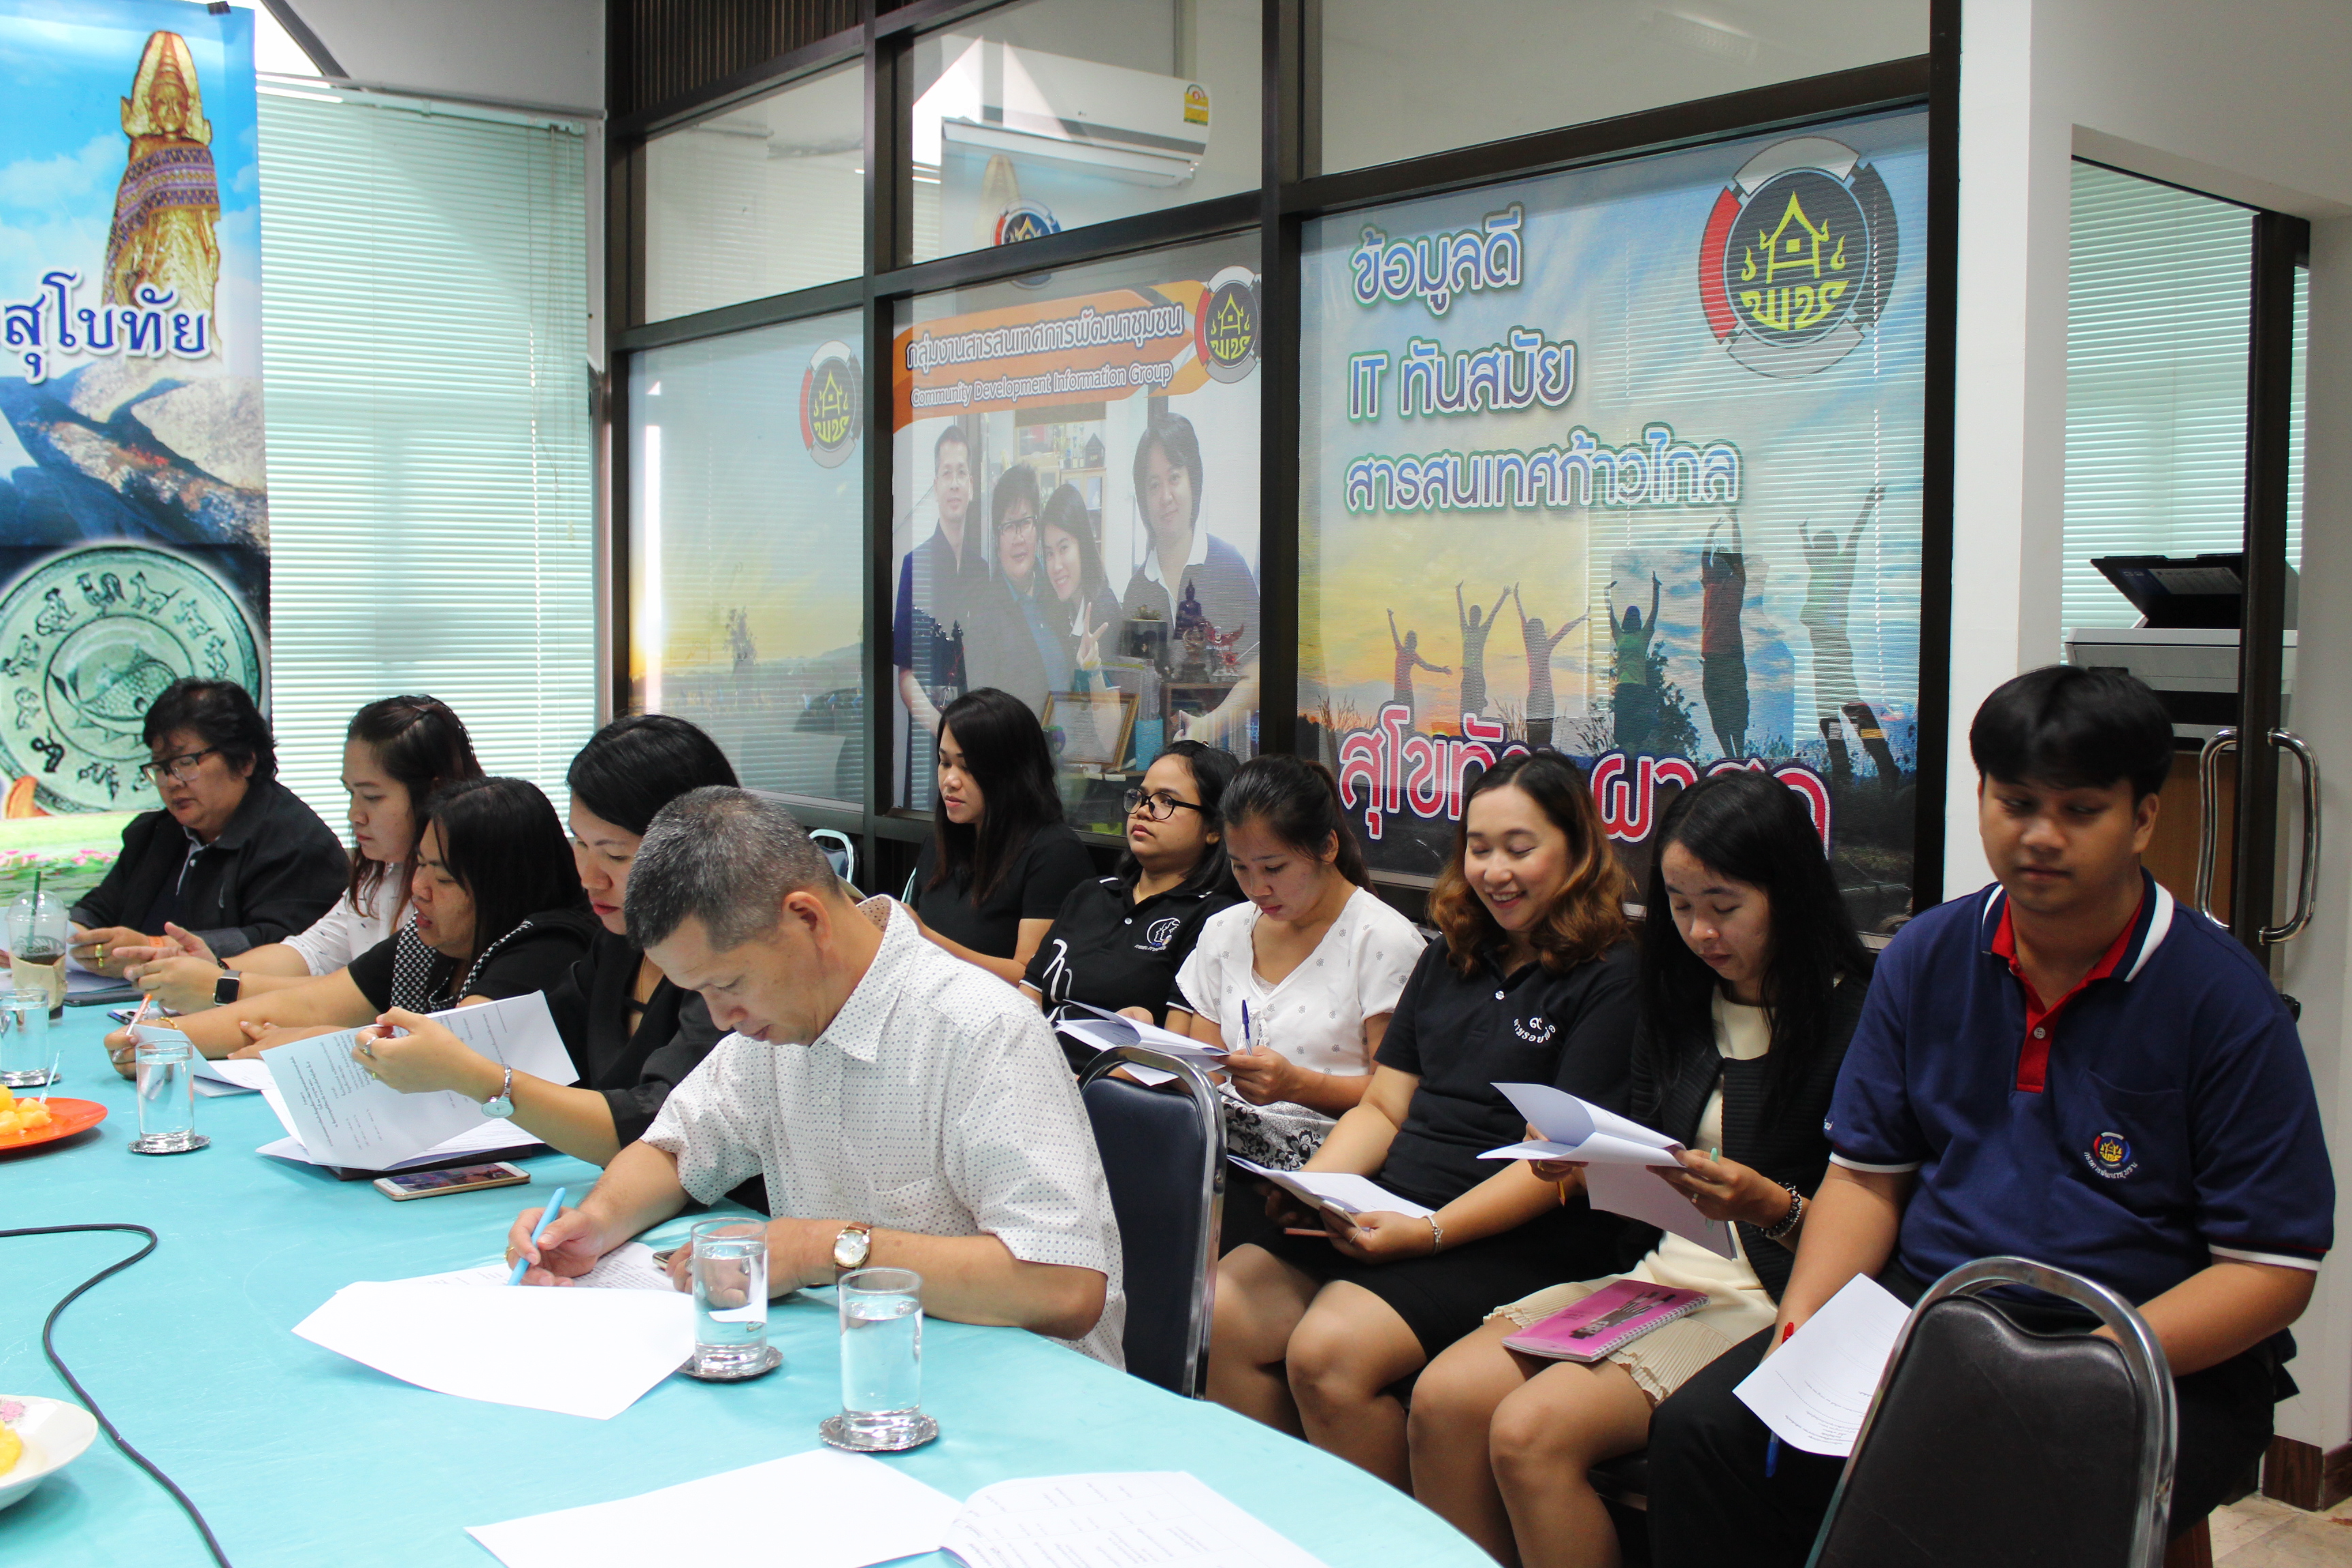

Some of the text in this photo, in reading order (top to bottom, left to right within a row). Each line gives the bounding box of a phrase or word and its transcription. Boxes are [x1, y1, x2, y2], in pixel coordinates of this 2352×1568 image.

[1352, 204, 1524, 316] ข้อมูลดี
[906, 304, 1184, 374] กลุ่มงานสารสนเทศการพัฒนาชุมชน
[1348, 329, 1576, 421] IT ทันสมัย
[911, 362, 1173, 407] Community Development Information Group
[1345, 426, 1742, 512] สารสนเทศก้าวไกล
[1339, 704, 1550, 840] สุโขทั
